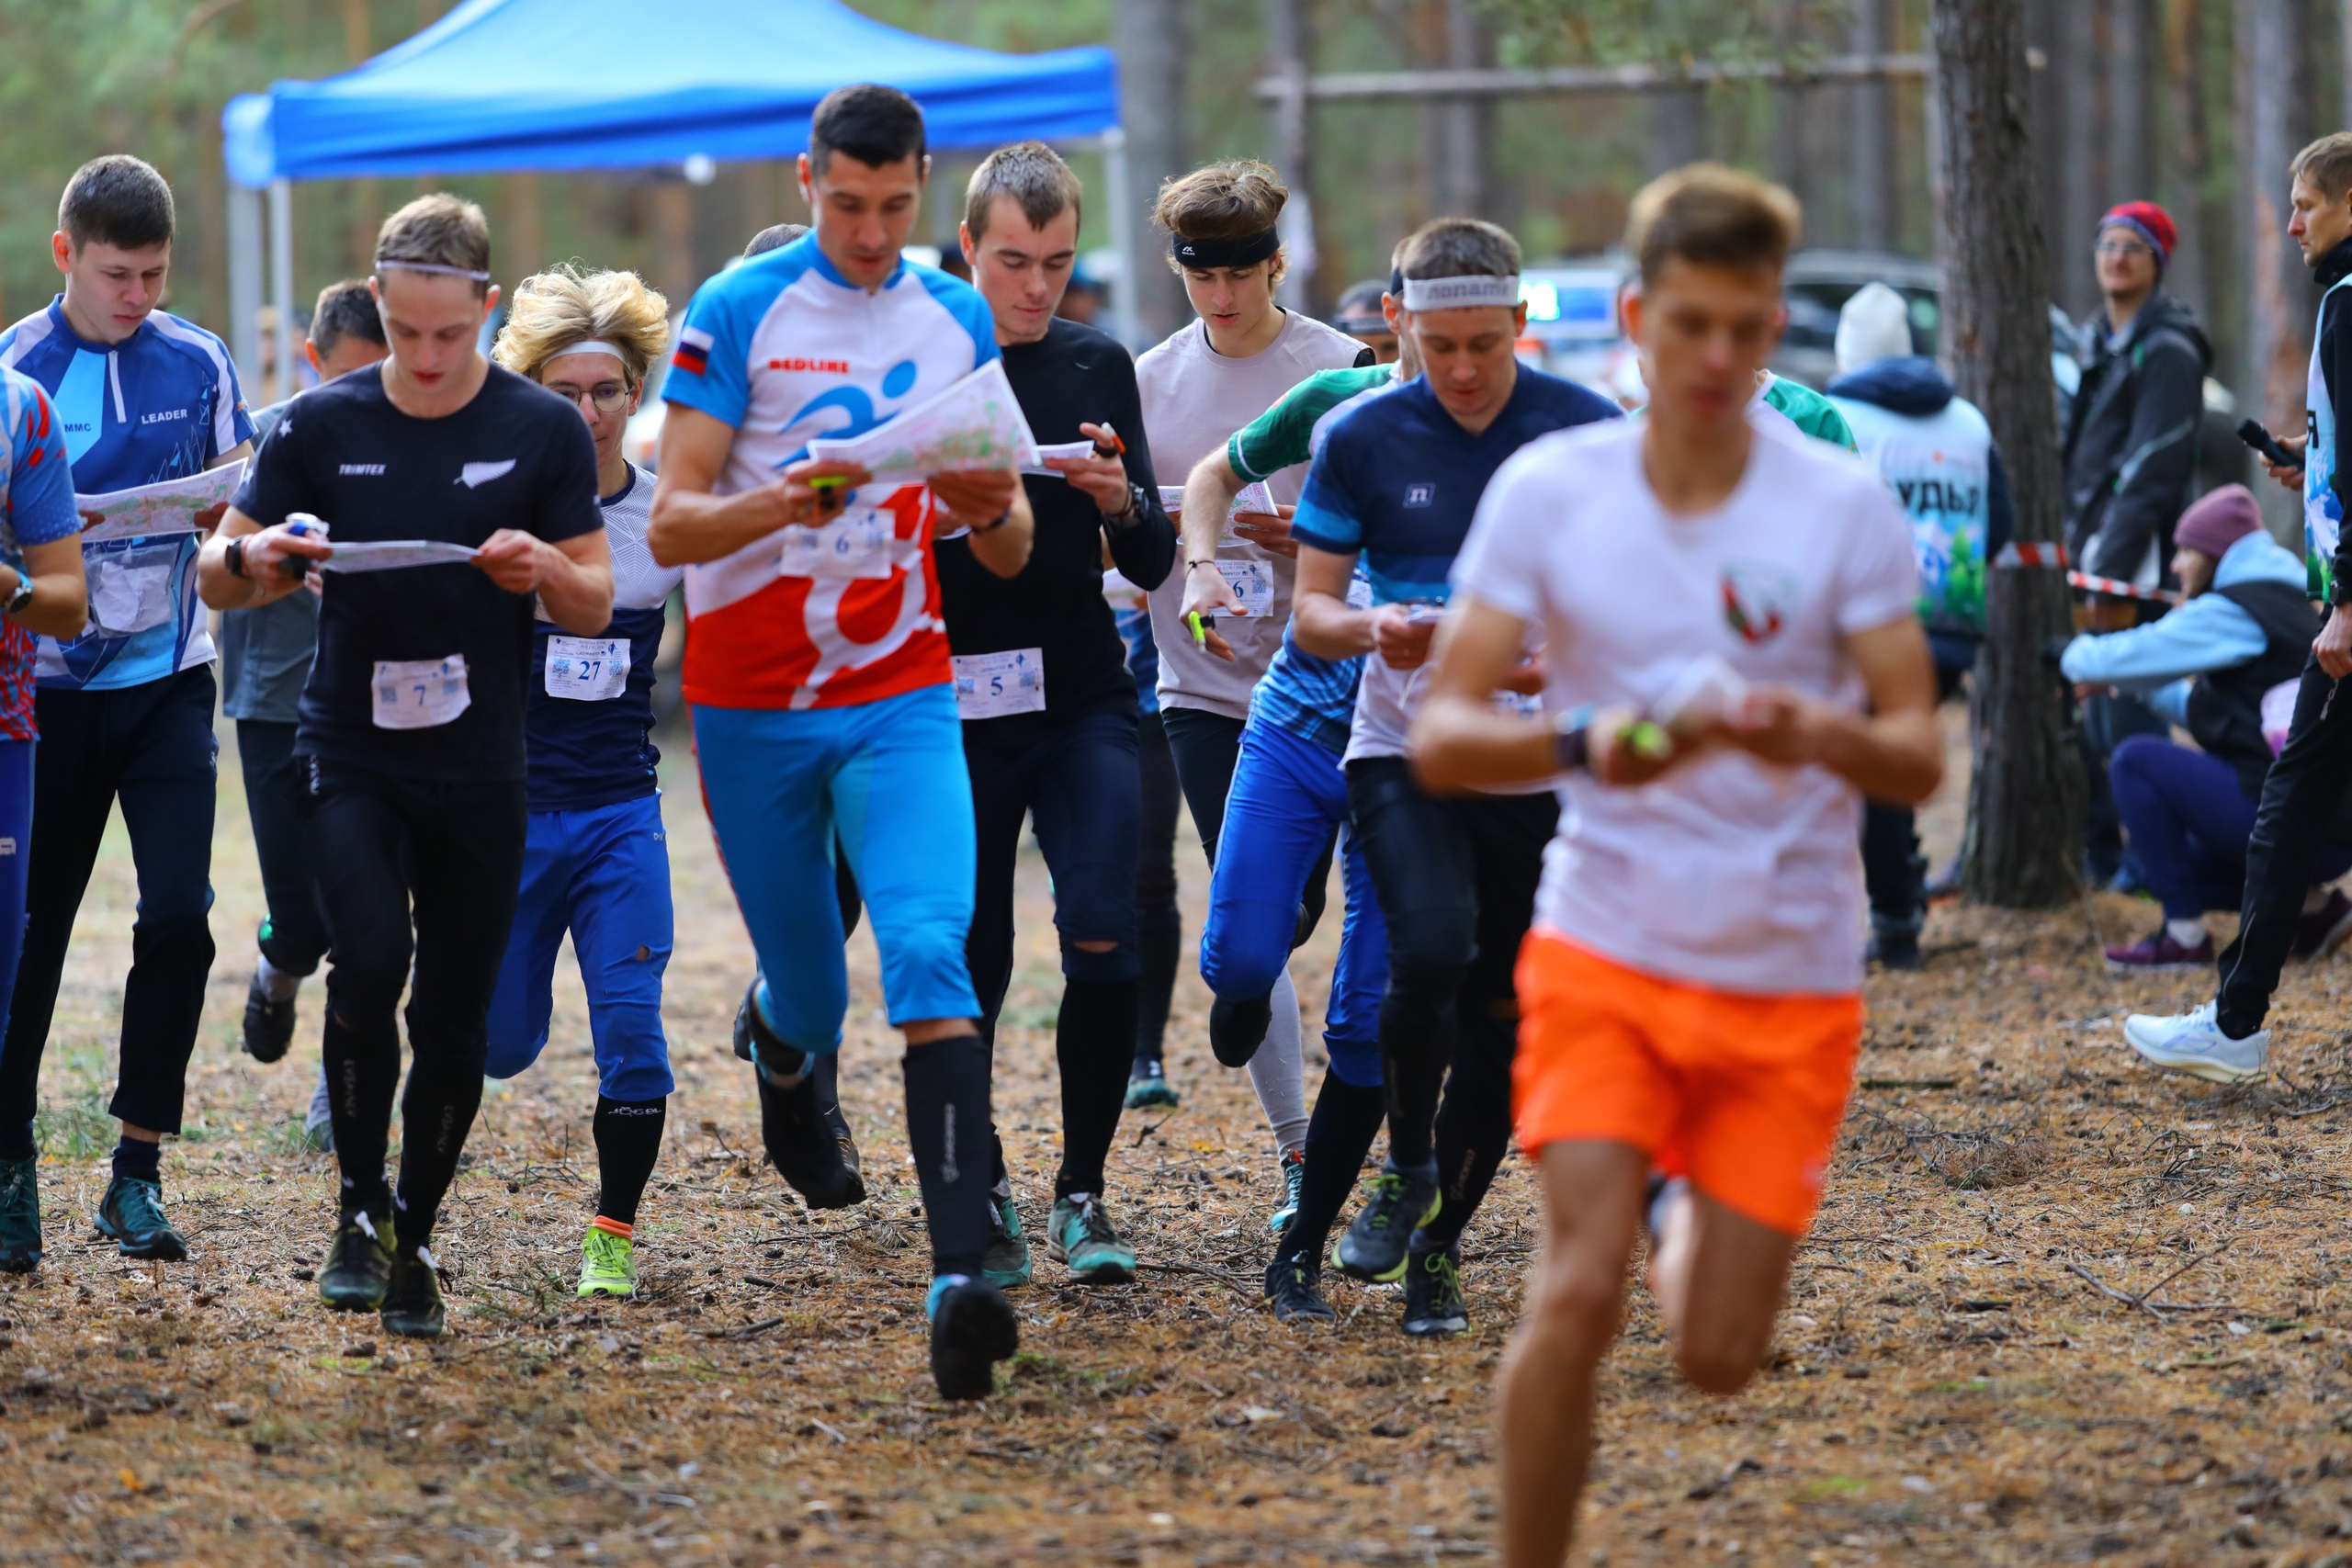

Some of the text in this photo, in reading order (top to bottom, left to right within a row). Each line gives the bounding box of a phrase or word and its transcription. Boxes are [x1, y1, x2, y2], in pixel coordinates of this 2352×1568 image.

[769, 358, 849, 375] REDLINE
[141, 409, 187, 424] LEADER
[339, 464, 386, 476] TRIMTEX
[835, 534, 849, 554] 6
[578, 660, 601, 681] 27
[413, 684, 425, 705] 7
[990, 675, 1003, 695] 5
